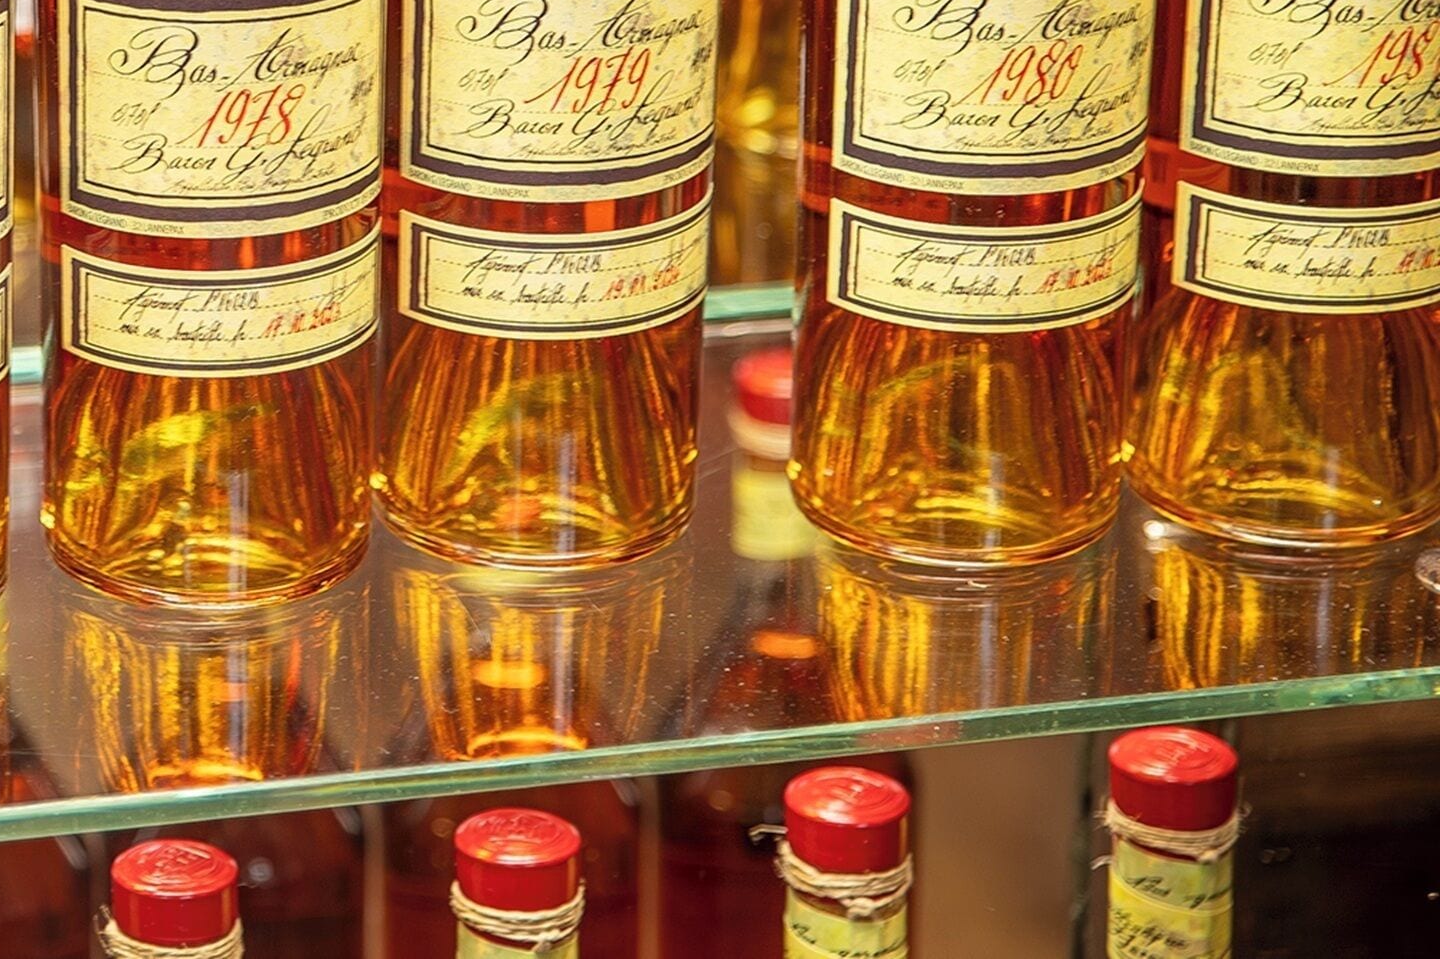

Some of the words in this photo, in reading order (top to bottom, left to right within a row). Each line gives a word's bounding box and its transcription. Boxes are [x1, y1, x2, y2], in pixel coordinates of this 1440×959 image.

[524, 46, 651, 115] 1979
[950, 39, 1083, 106] 1980
[1323, 20, 1440, 88] 198
[176, 83, 305, 149] 1978
[450, 99, 563, 138] Baron
[884, 90, 1000, 129] Baron
[106, 133, 218, 174] Baron
